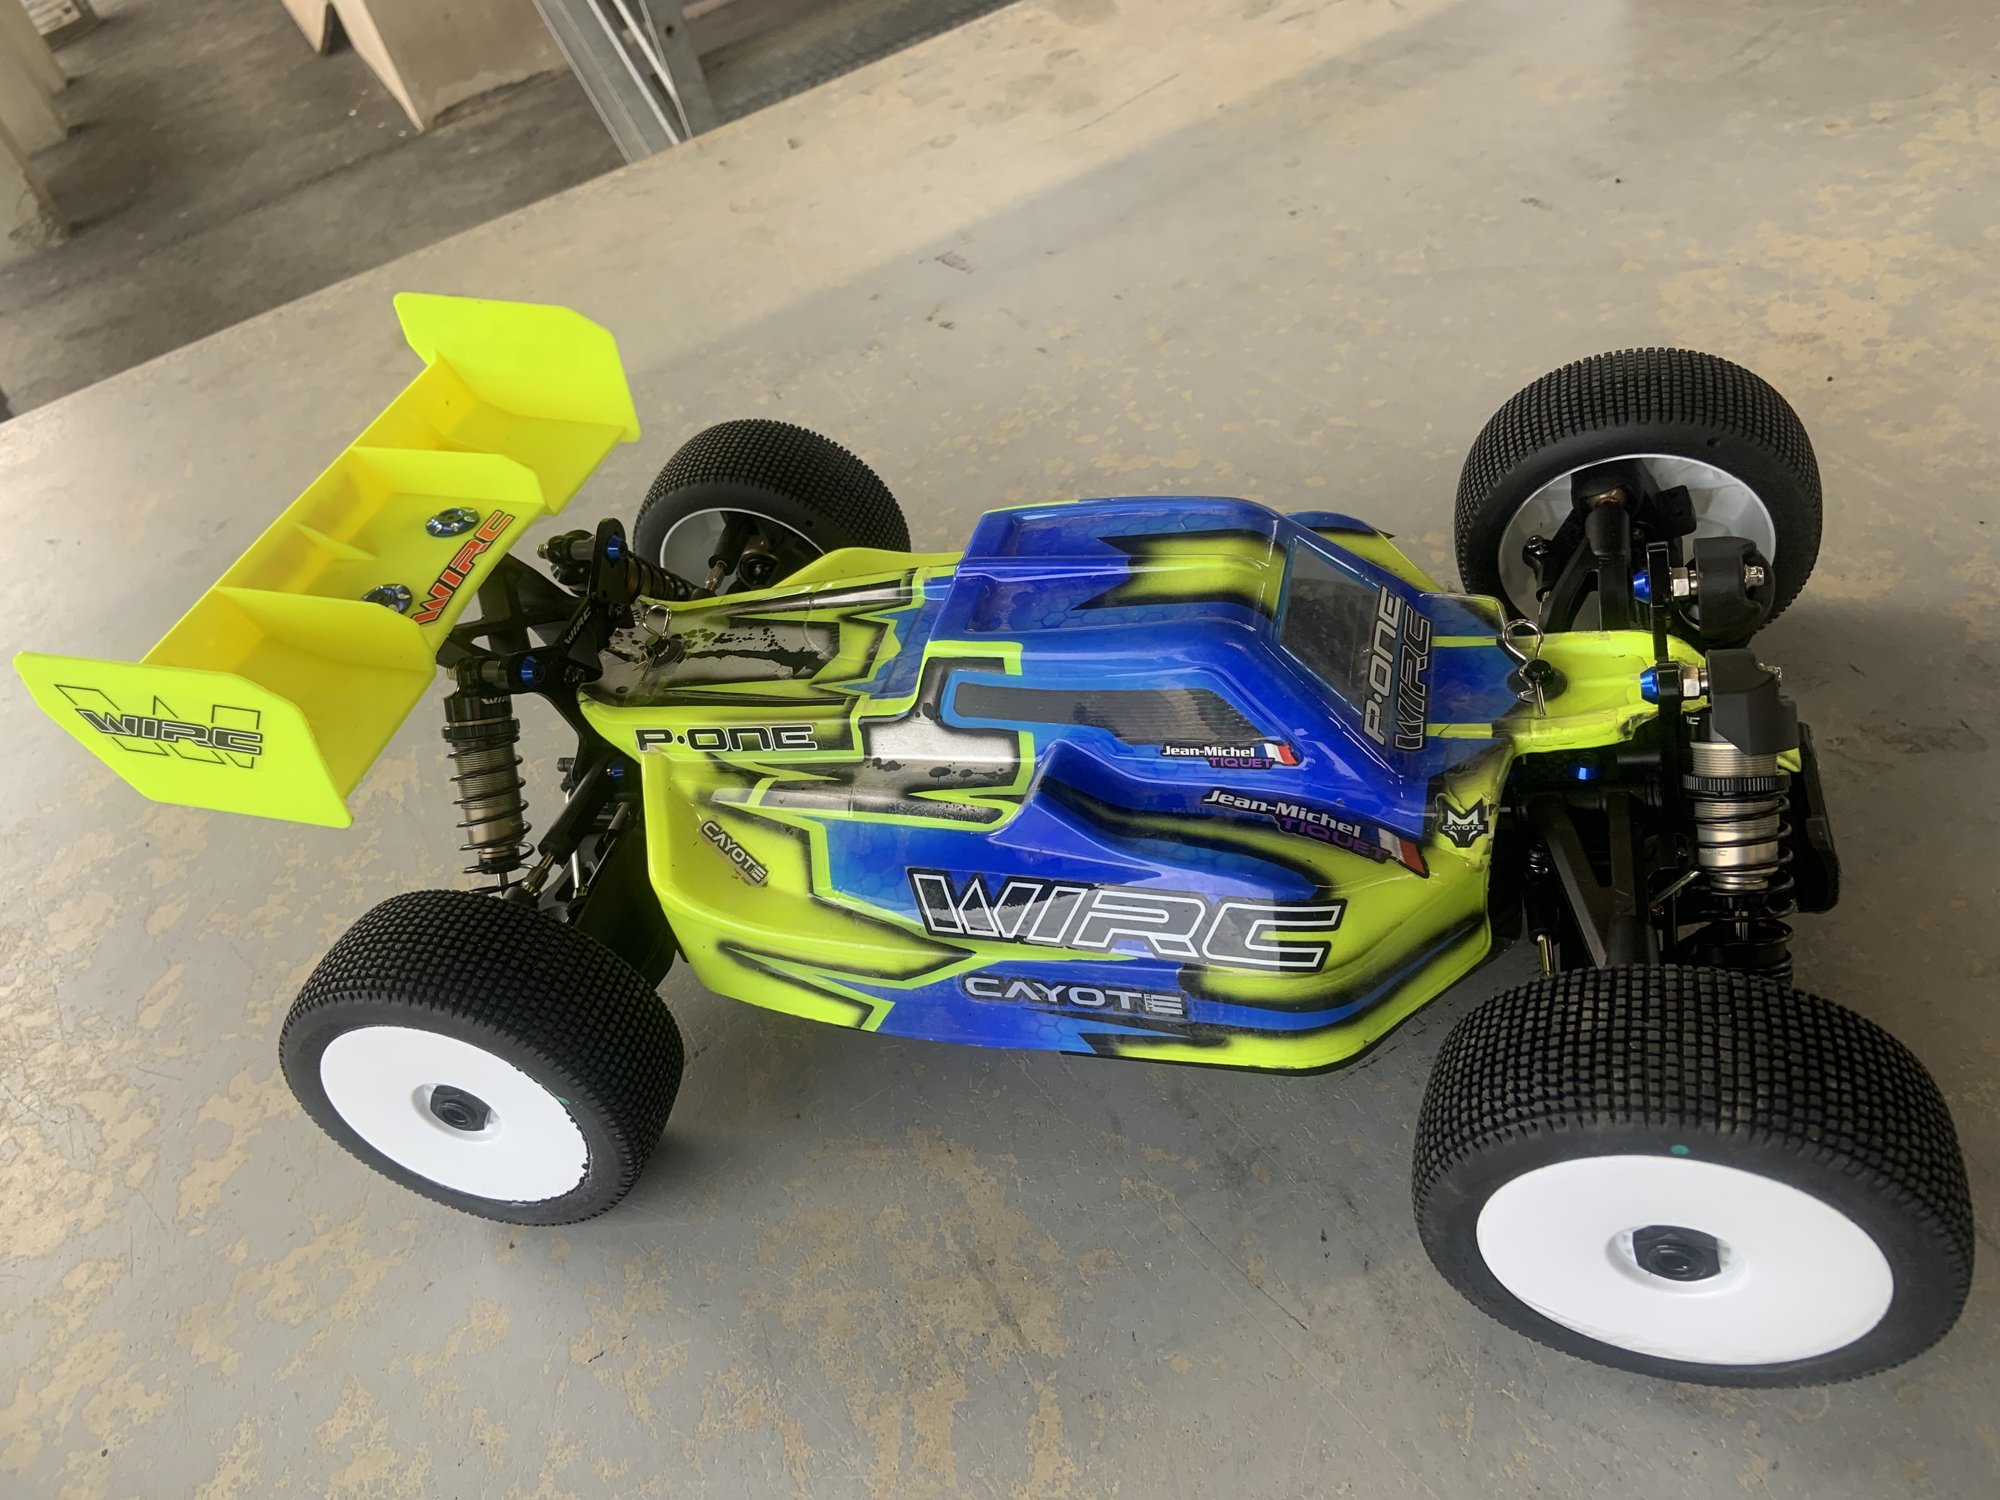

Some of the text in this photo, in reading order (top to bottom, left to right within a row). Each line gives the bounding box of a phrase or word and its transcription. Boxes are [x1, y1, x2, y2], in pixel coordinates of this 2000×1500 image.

[410, 509, 516, 625] WIRC
[480, 696, 511, 705] WIR
[1395, 604, 1431, 750] WIRC
[75, 707, 263, 756] WIRC
[1162, 745, 1255, 757] Jean-Michel
[1209, 757, 1274, 768] TIQUET
[1203, 790, 1362, 838] Jean-Michel
[702, 821, 767, 883] CAYOTE
[1281, 817, 1392, 860] TIQUET
[910, 870, 1344, 970] WIRC
[965, 976, 1183, 1015] CAYOTE
